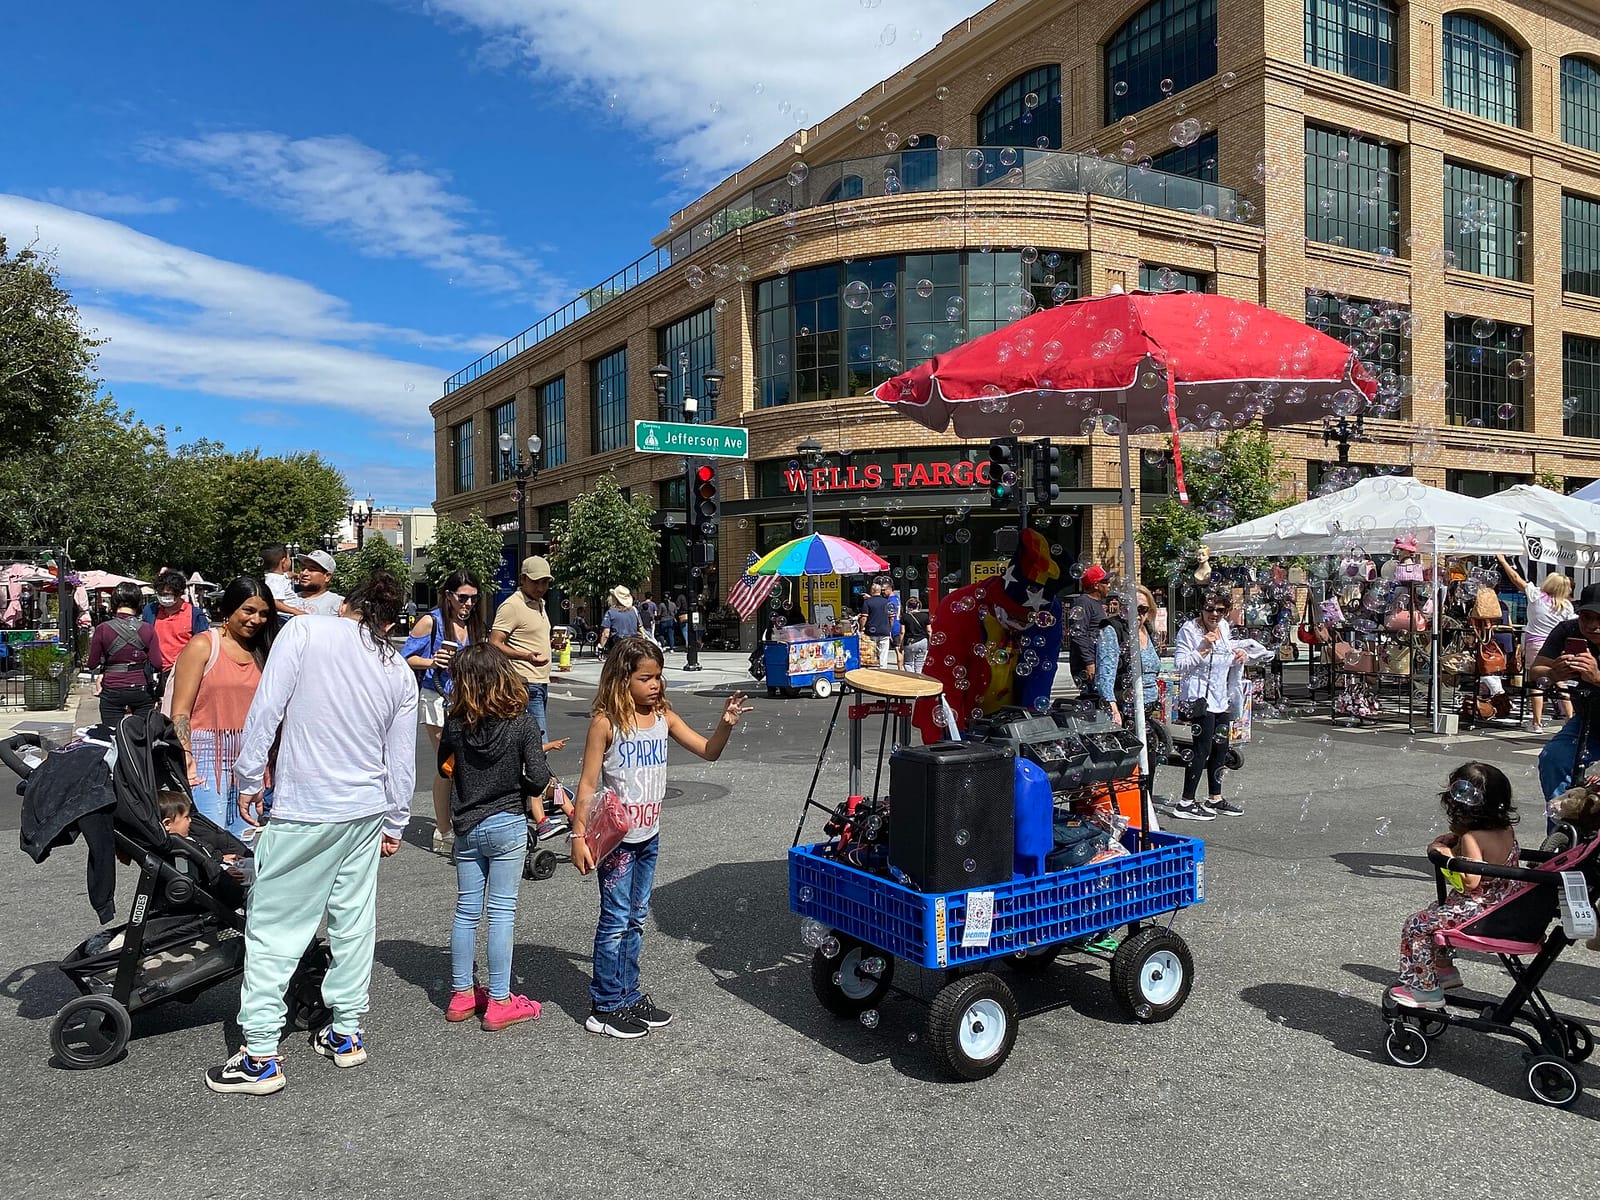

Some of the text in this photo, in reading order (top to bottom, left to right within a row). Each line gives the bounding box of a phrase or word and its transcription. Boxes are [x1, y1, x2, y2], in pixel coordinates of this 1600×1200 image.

[664, 431, 743, 448] Jefferson Ave
[783, 464, 883, 492] WELLS
[890, 525, 918, 537] 2099
[974, 564, 1007, 575] Easie
[133, 895, 147, 922] MODES
[1574, 910, 1591, 919] SFO
